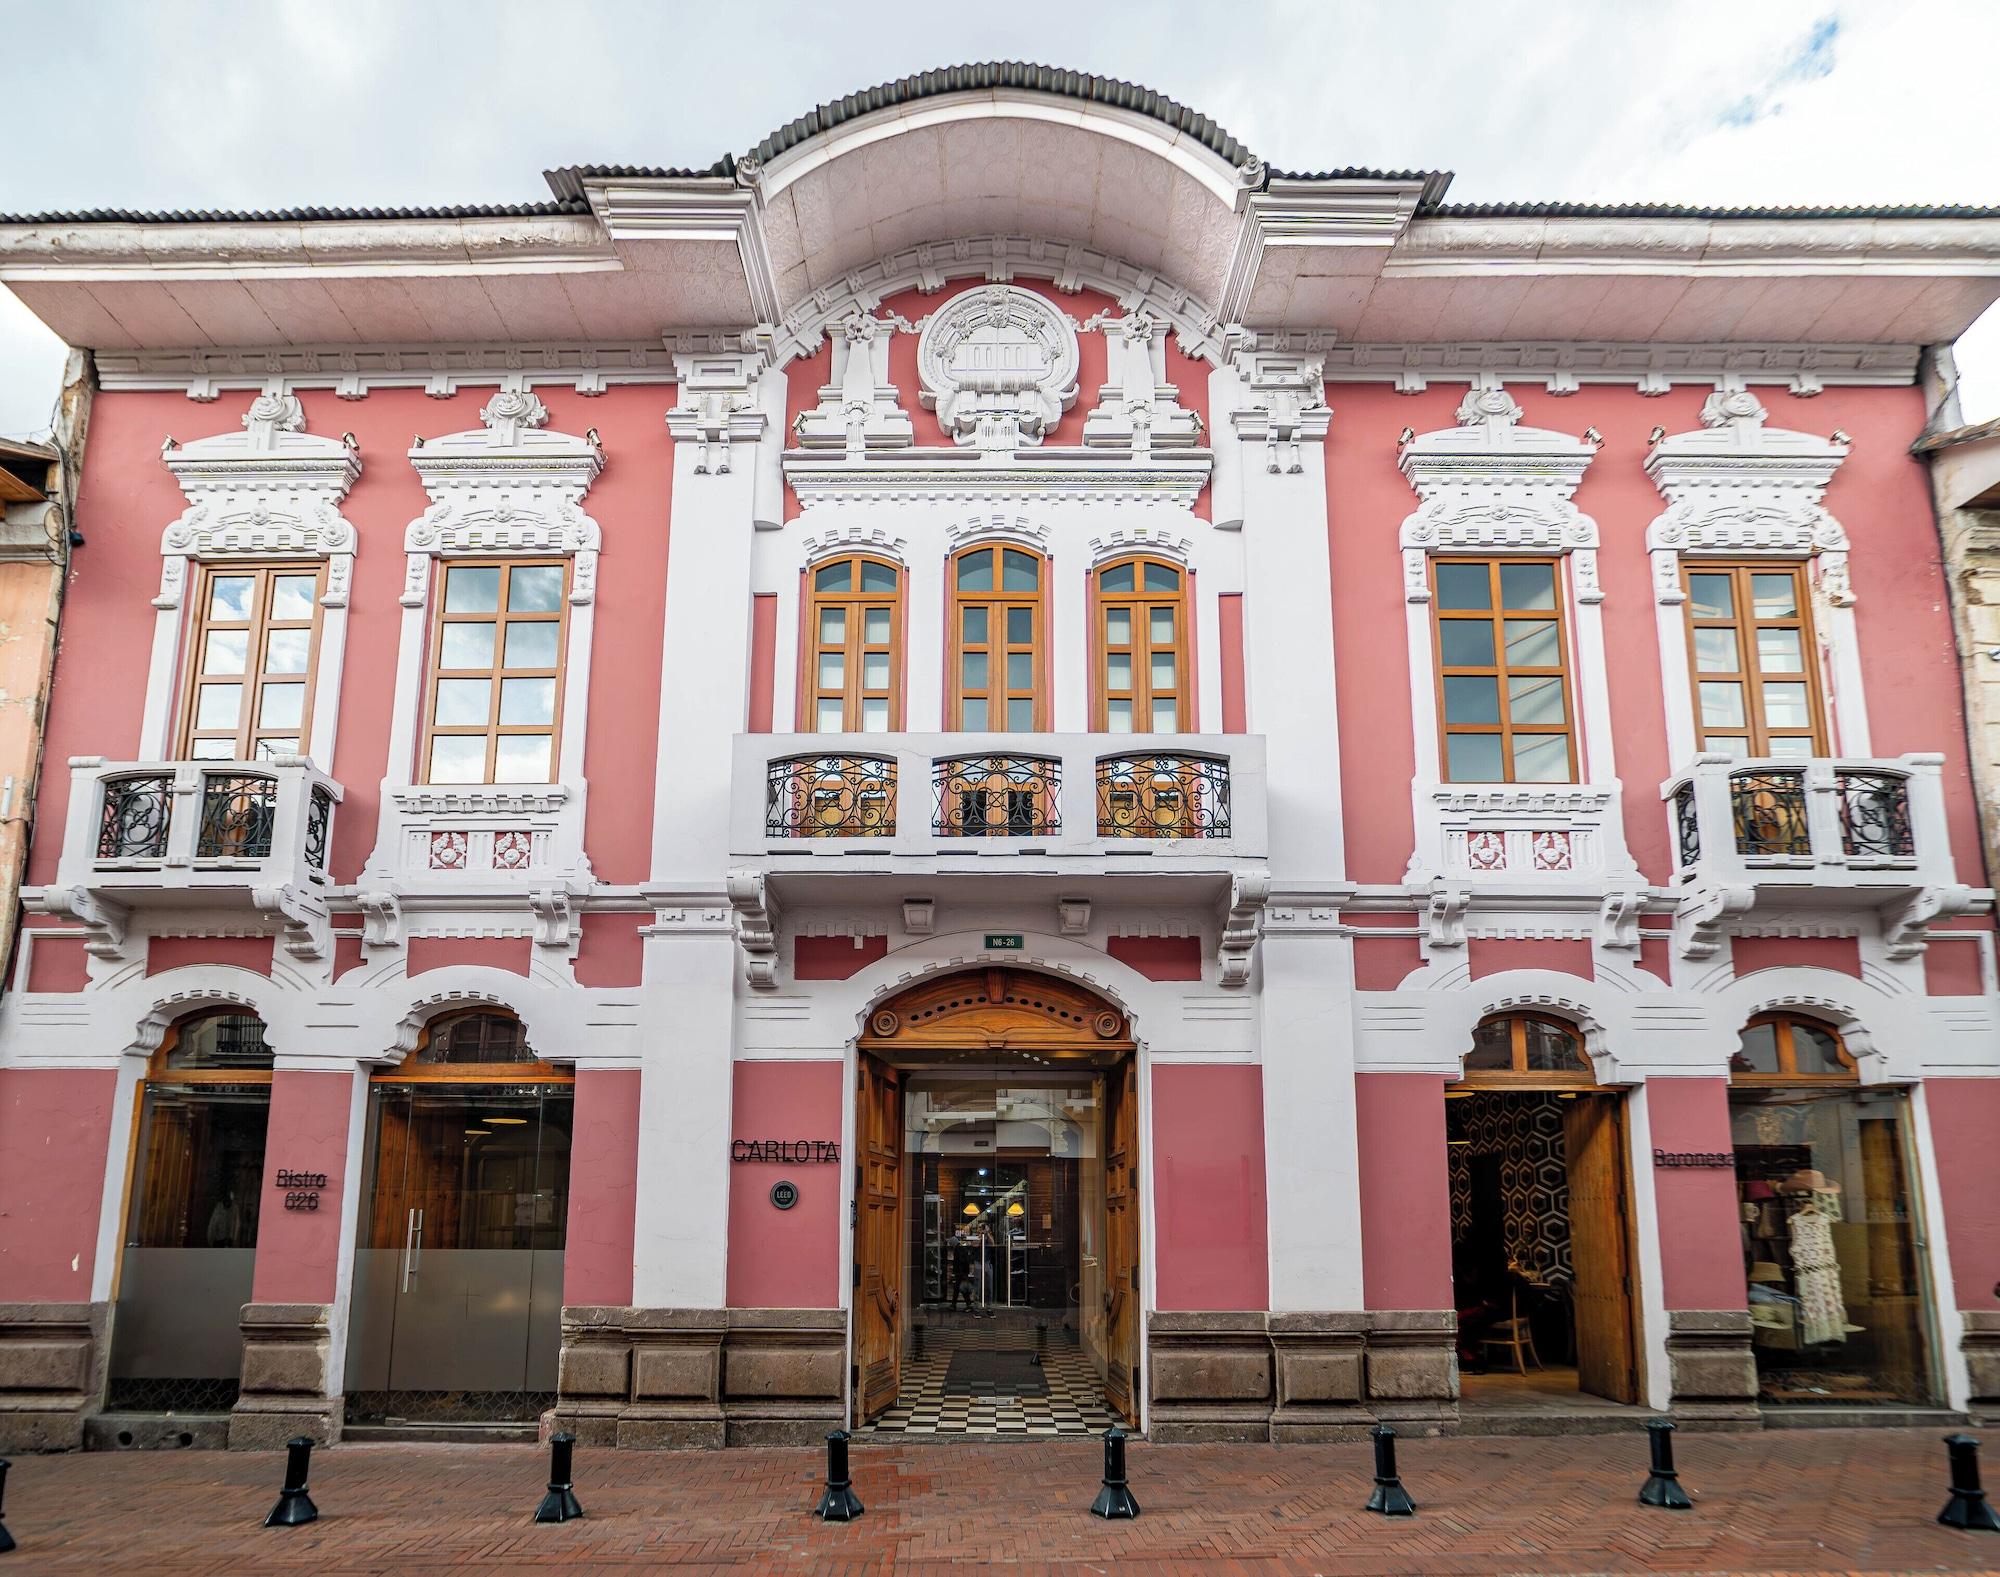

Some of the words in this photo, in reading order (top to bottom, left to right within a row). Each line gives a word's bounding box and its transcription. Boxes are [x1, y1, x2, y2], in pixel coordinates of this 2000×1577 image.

[732, 1139, 839, 1163] CARLOTA
[276, 1169, 327, 1188] Bistro
[285, 1192, 319, 1211] 626
